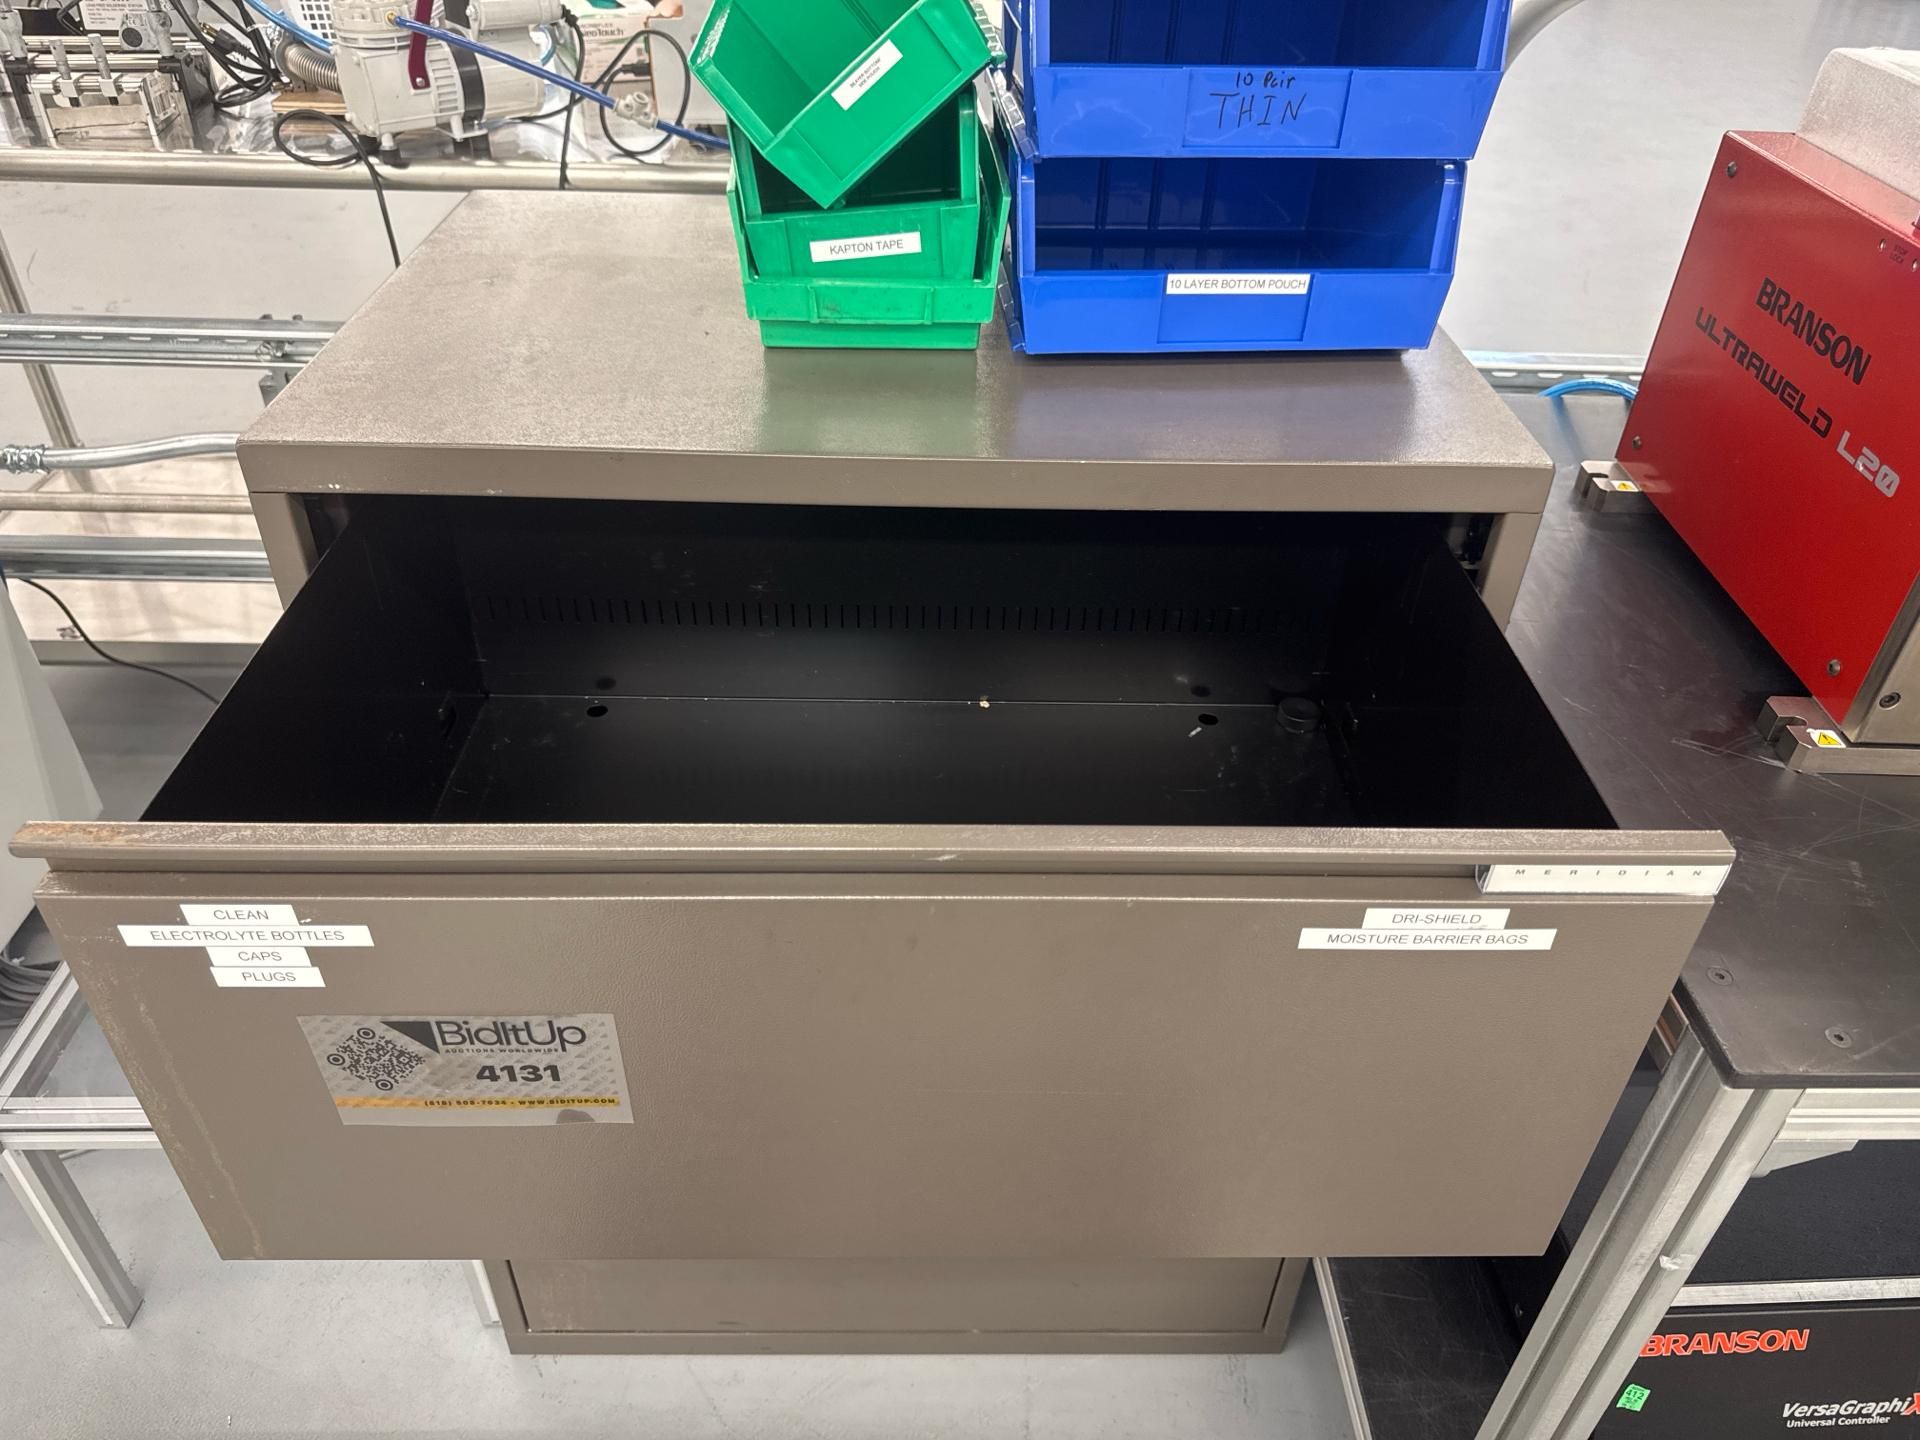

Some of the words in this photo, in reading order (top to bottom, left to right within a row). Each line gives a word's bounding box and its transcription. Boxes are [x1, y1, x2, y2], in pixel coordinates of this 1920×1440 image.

[1235, 71, 1254, 88] 10
[1263, 70, 1296, 89] Pair
[1208, 92, 1308, 129] THIN
[829, 241, 873, 256] KAPTON
[875, 239, 904, 250] TAPE
[1169, 279, 1182, 289] 10
[1184, 279, 1219, 289] LAYER
[1220, 279, 1266, 289] BOTTOM
[1268, 279, 1307, 289] POUCH
[1756, 277, 1872, 386] BRANSON
[1695, 306, 1833, 439] ULTRAWELD
[1836, 430, 1900, 498] L20
[212, 909, 270, 921] CLEAN
[1391, 913, 1483, 925] DRI-SHIELD
[150, 930, 268, 942] ELECTROLYTE
[270, 930, 346, 942] BOTTLES
[1326, 933, 1410, 945] MOISTURE
[1411, 934, 1483, 945] BARRIER
[1484, 934, 1530, 945] BAGS
[237, 951, 283, 962] CAPS
[240, 971, 297, 983] PLUGS
[434, 1020, 587, 1053] BidItUp
[476, 1064, 561, 1082] 4131
[518, 1098, 616, 1106] WWW.BIDITUP.COM
[1639, 1328, 1811, 1357] BRANSON
[1625, 1389, 1645, 1401] 412
[1786, 1417, 1836, 1428] Universal
[1837, 1415, 1891, 1426] Controller
